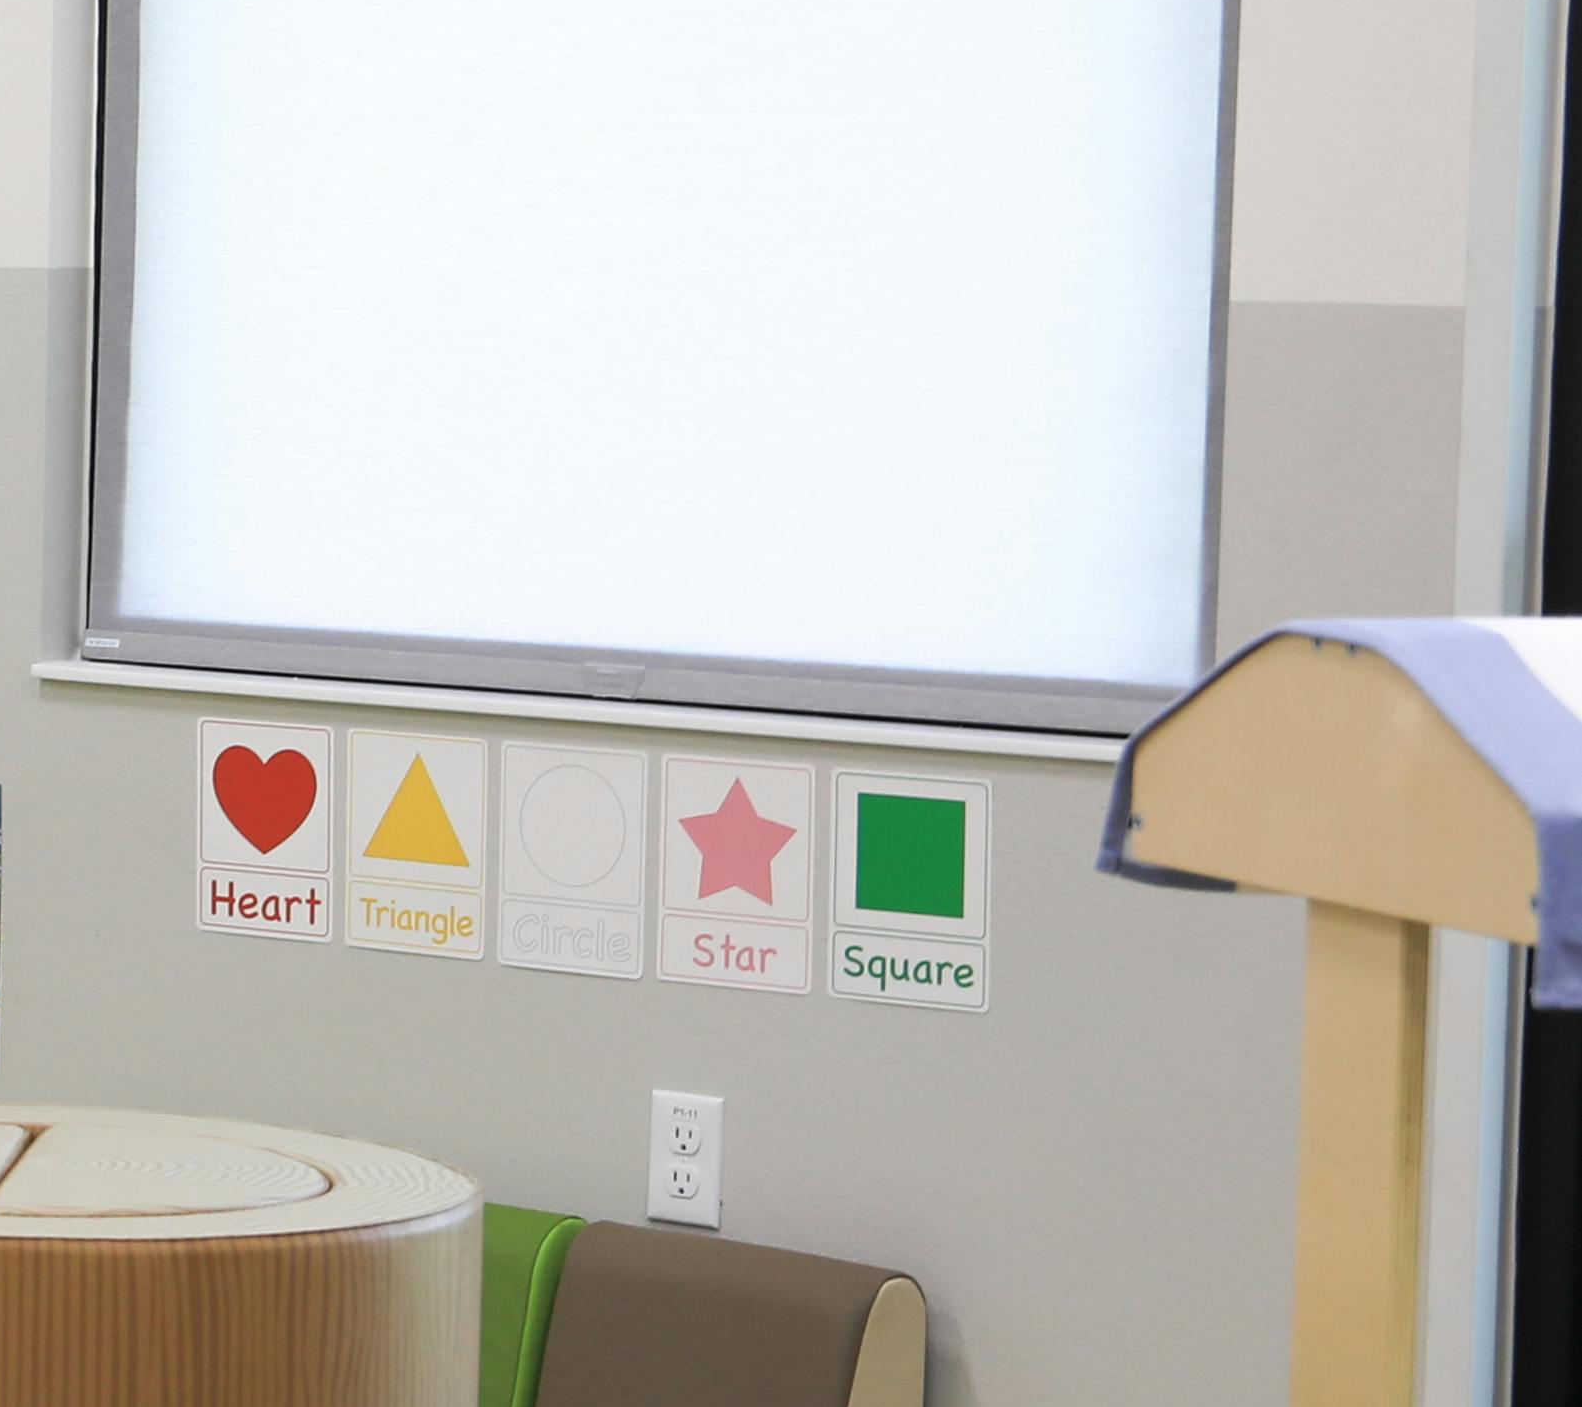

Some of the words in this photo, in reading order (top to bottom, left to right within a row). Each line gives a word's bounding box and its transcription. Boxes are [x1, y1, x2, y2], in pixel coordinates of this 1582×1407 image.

[210, 880, 322, 925] Heart
[359, 897, 474, 945] Triangle
[512, 913, 632, 963] Circle
[692, 932, 777, 973] Star
[843, 945, 975, 991] Square
